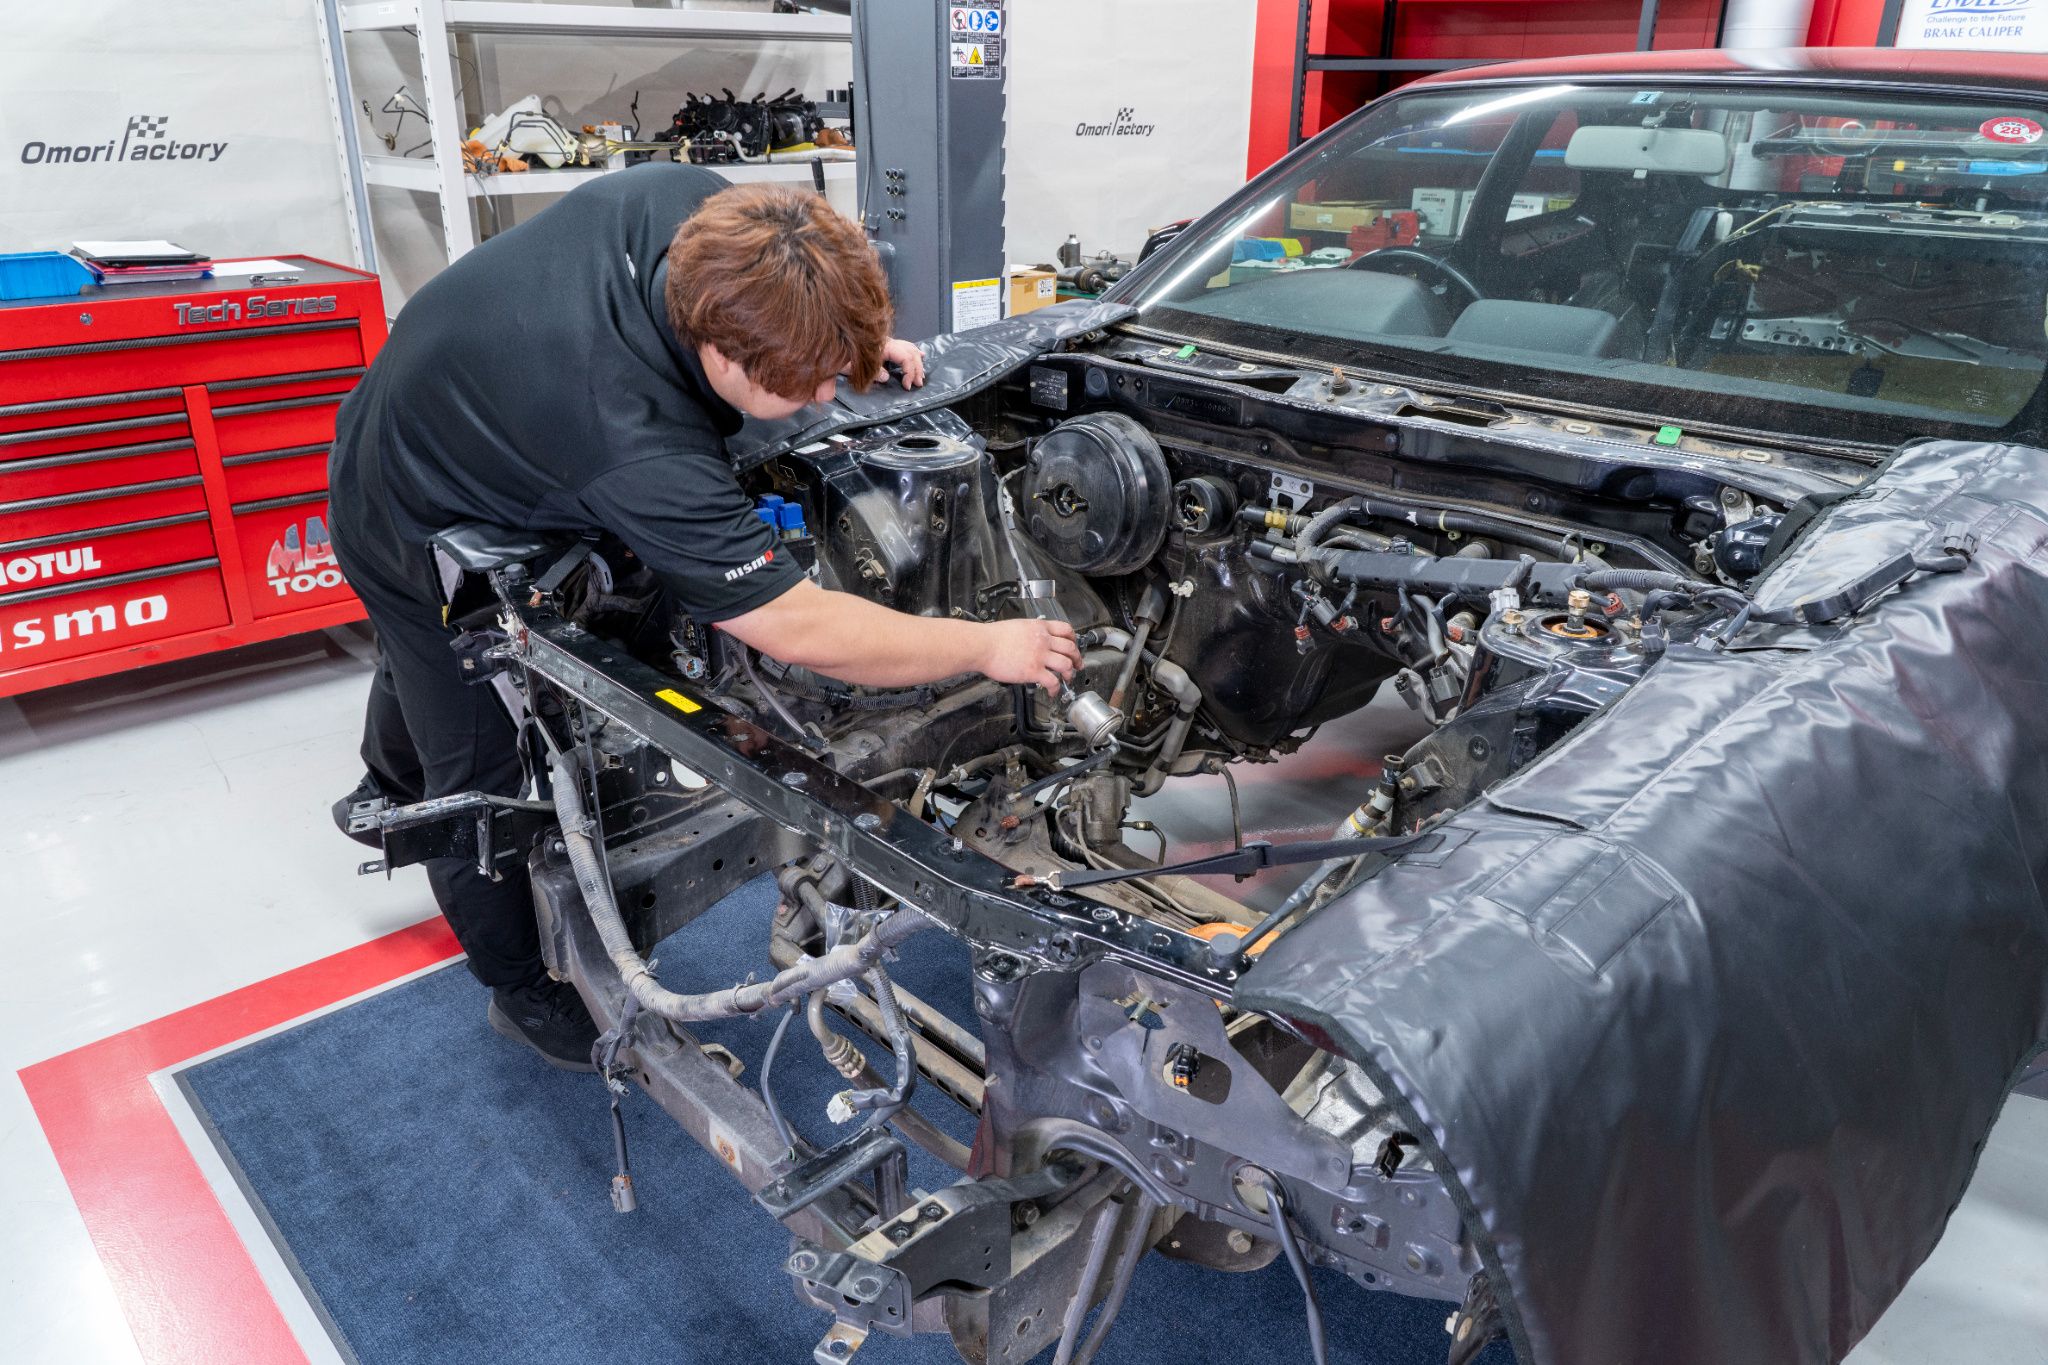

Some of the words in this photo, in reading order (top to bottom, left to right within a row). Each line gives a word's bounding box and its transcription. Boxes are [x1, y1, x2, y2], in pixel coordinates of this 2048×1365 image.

[1926, 16, 1968, 24] Challenge
[1981, 14, 1995, 22] the
[1997, 14, 2026, 22] Future
[1923, 27, 1965, 39] BRAKE
[1968, 26, 2024, 38] CALIPER
[1075, 122, 1112, 136] Omori
[2000, 126, 2022, 135] 28
[21, 140, 116, 164] Omori
[173, 299, 242, 326] Tech
[246, 295, 337, 319] Series
[267, 515, 339, 578] MA
[724, 549, 774, 581] nismo
[268, 569, 348, 597] TOO
[0, 594, 168, 652] smo
